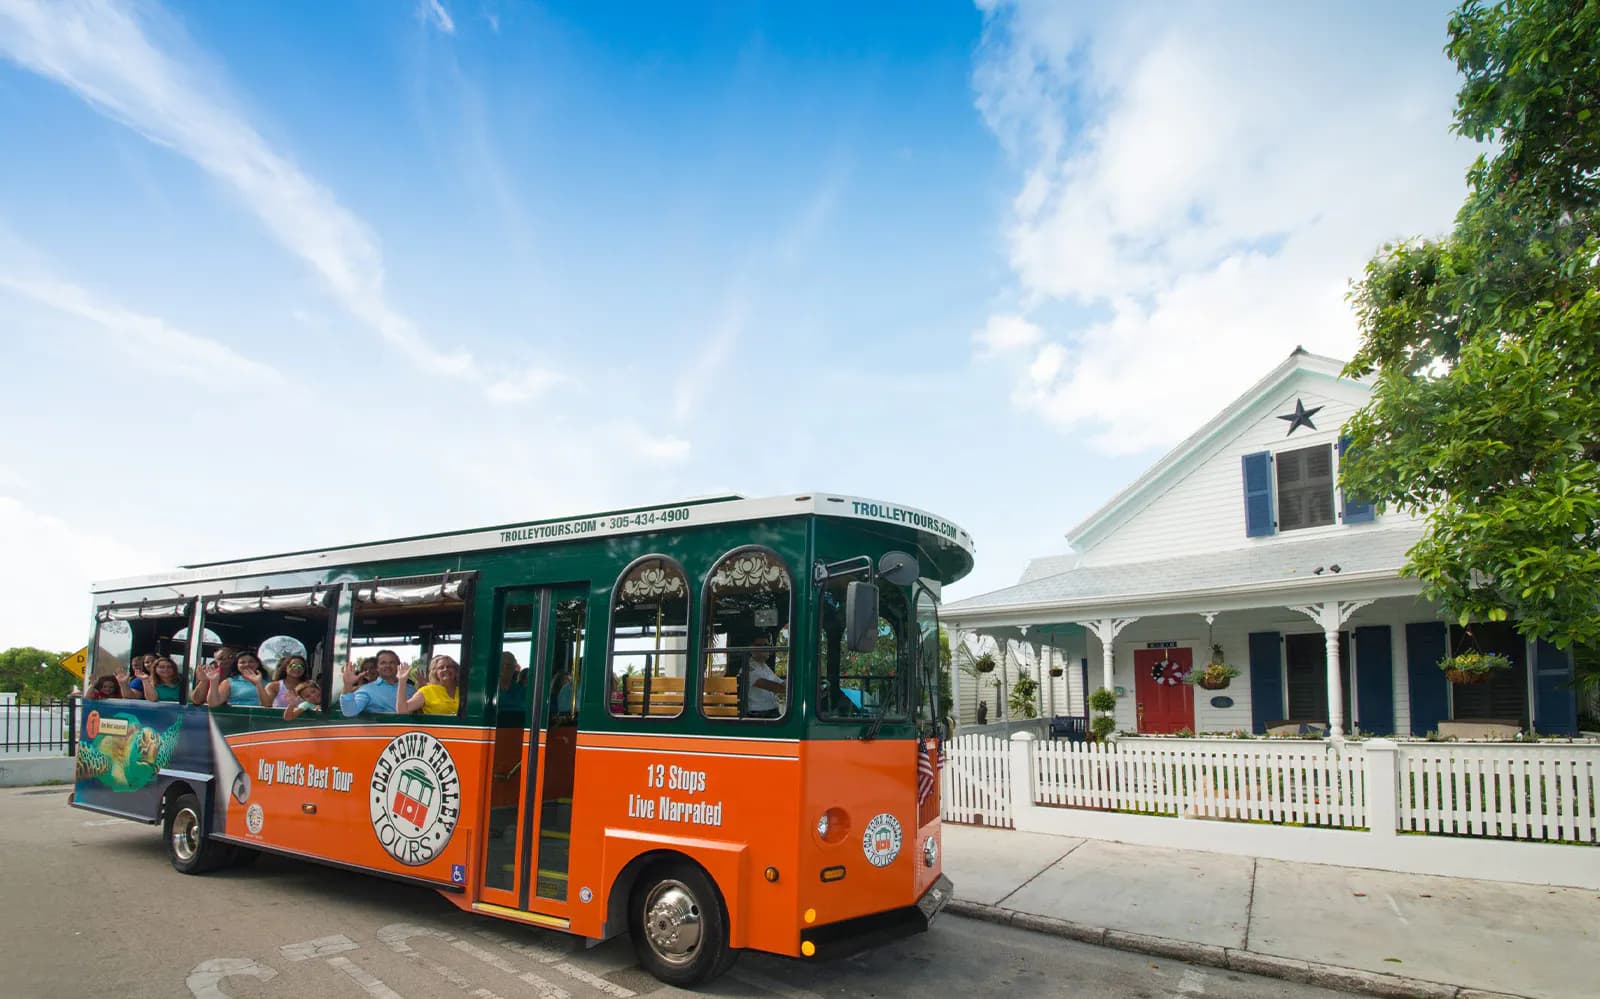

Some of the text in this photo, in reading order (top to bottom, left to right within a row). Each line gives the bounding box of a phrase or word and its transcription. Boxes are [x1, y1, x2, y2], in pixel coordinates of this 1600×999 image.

[500, 508, 690, 543] TROLLEYTOURS.COM 305-434-4900
[852, 501, 957, 540] TROLLEYTOURS.COM
[258, 758, 353, 792] Key West's Best Tour
[372, 734, 459, 834] OLD TOWN TROLLEY
[647, 764, 706, 795] 13 Stops
[628, 793, 722, 826] Live Narrated
[374, 805, 434, 863] TOURS
